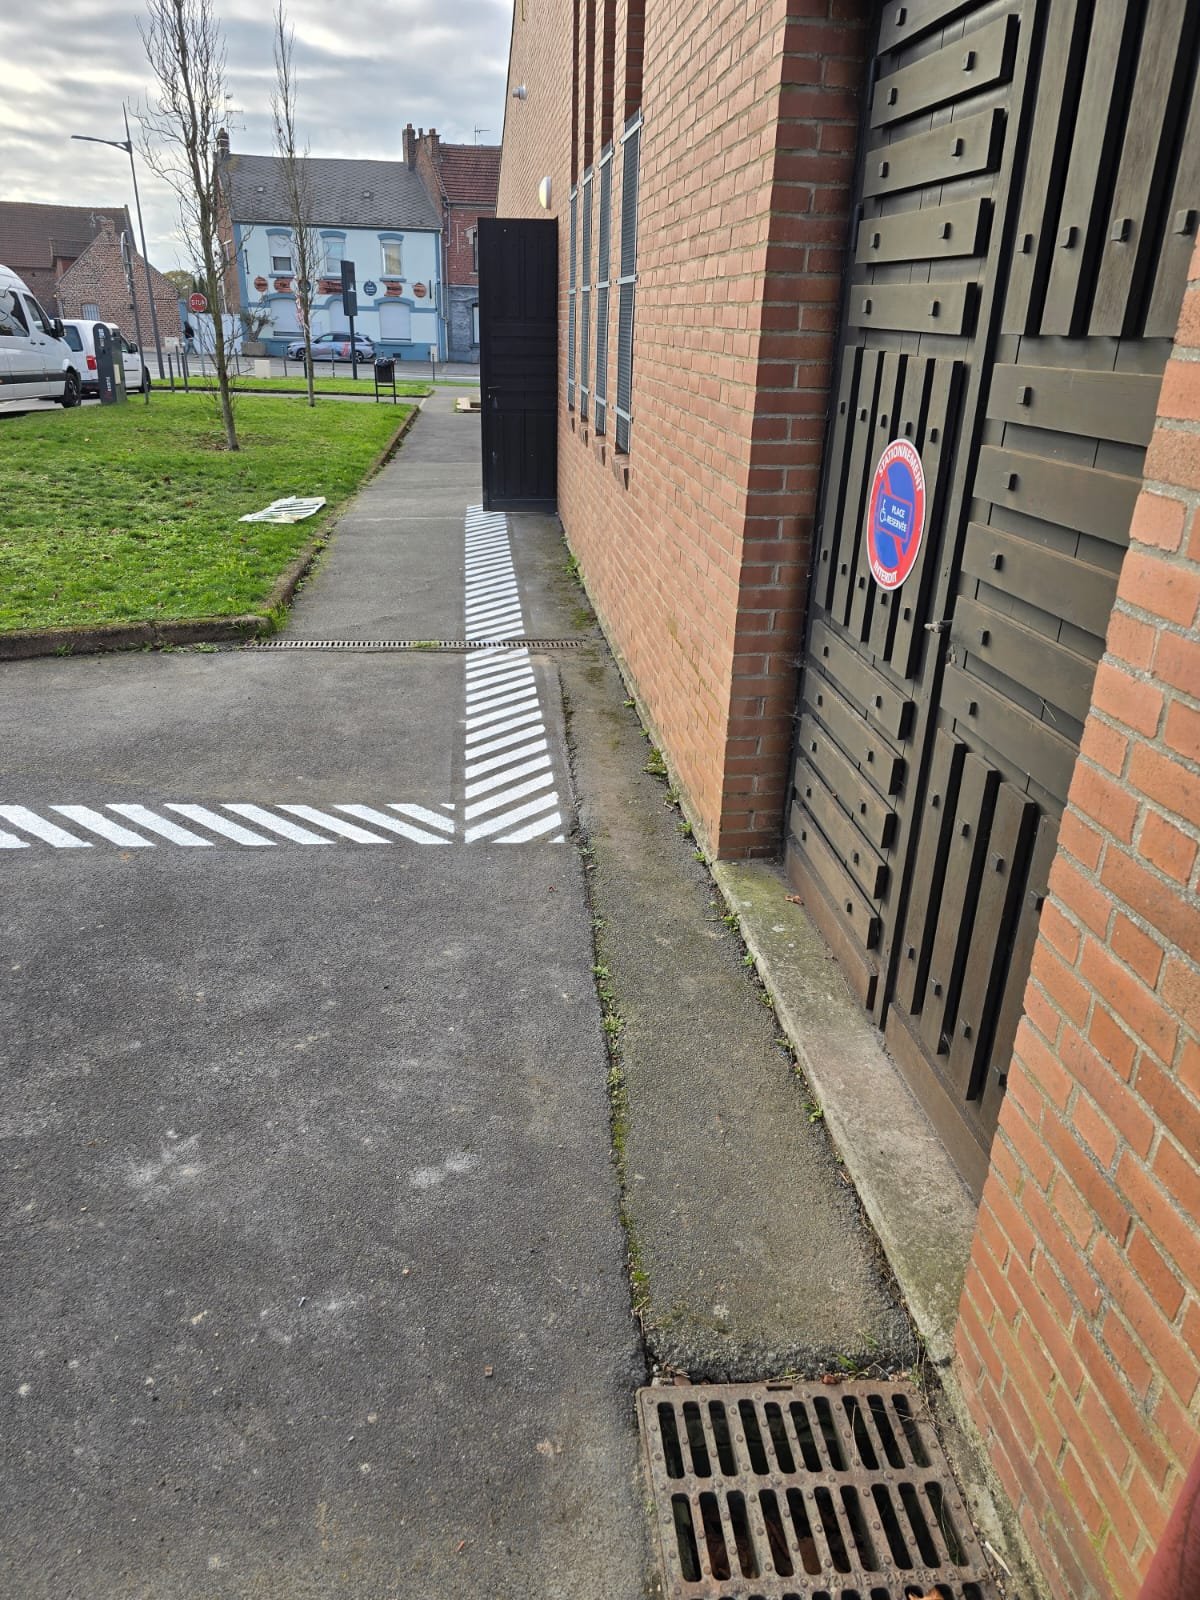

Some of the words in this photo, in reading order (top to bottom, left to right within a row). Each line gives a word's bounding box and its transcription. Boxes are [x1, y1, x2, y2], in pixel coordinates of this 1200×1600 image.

[878, 445, 923, 492] STATIONNEMENT
[891, 504, 906, 519] PLACE
[873, 560, 898, 583] INTERDIT
